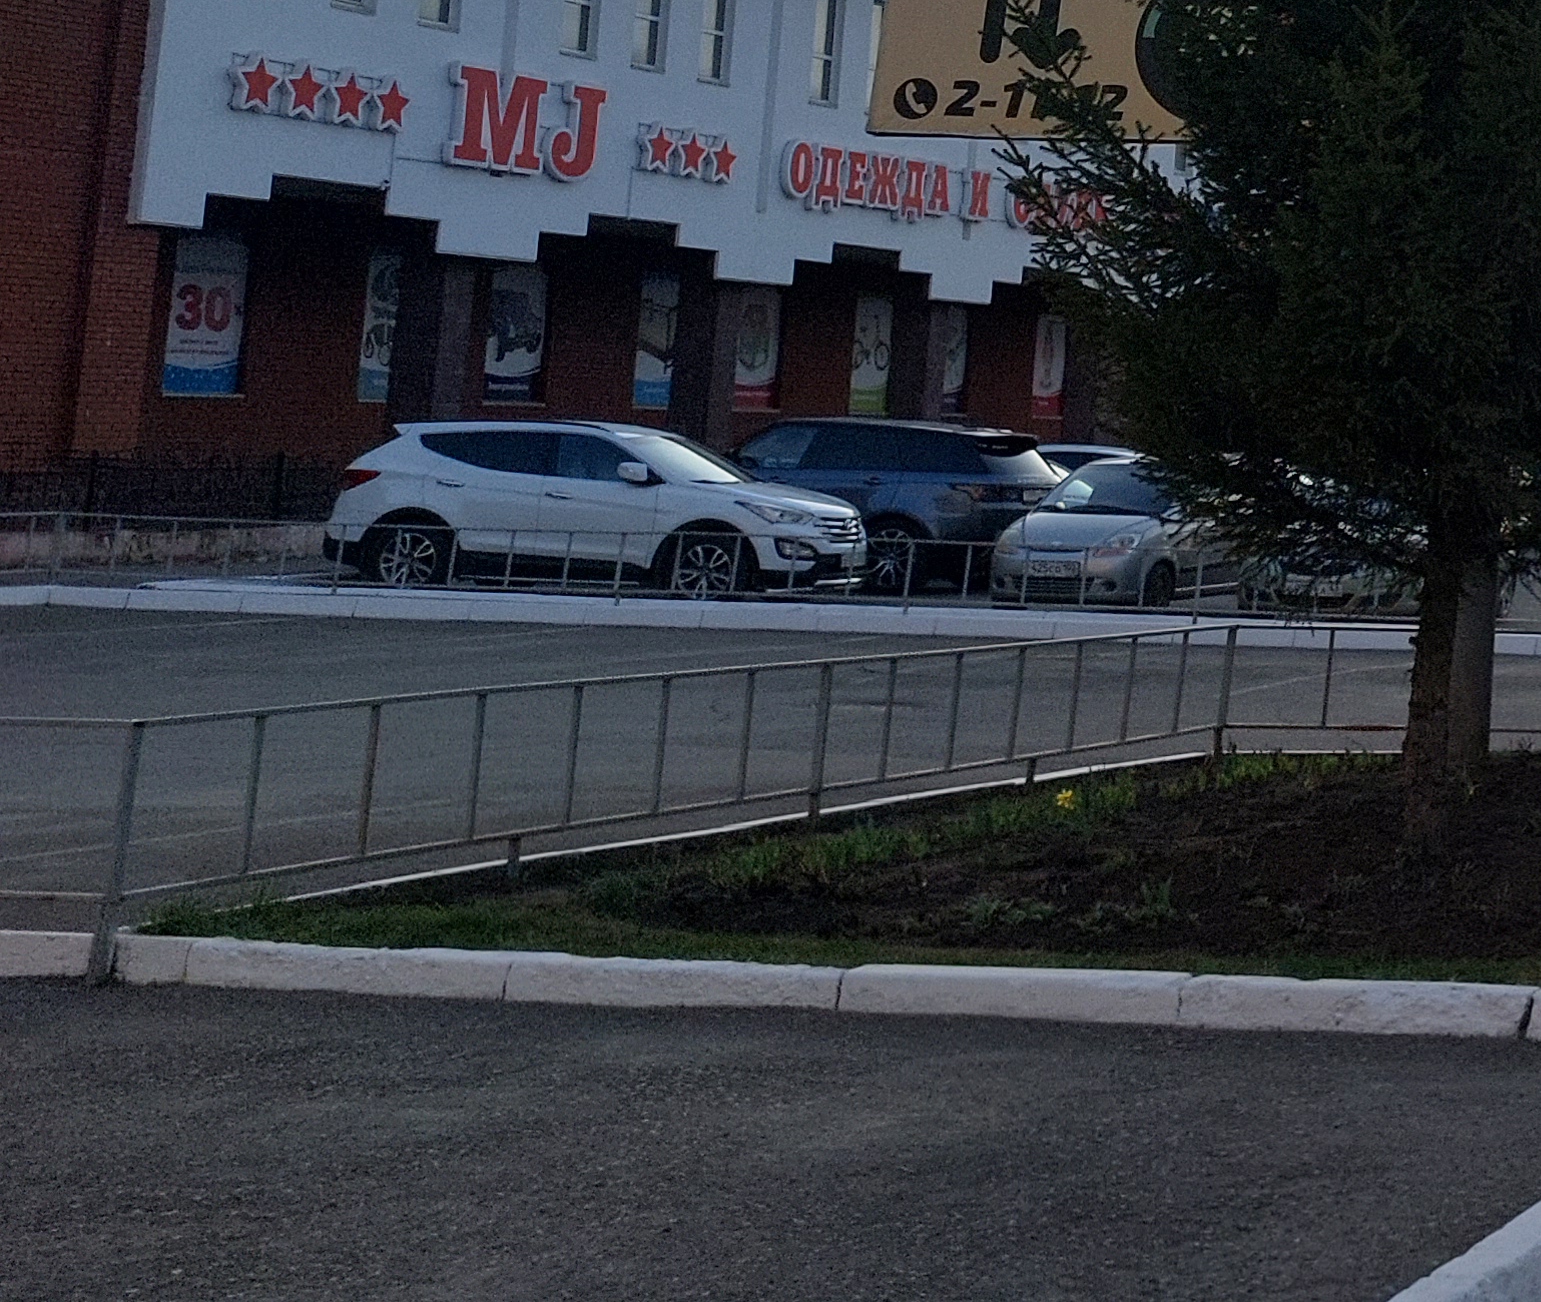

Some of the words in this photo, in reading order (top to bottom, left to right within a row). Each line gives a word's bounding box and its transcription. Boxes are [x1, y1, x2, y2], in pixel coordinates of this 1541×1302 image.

[450, 64, 608, 180] MJ
[788, 141, 950, 218] ОДЕЖДА
[967, 169, 992, 219] И
